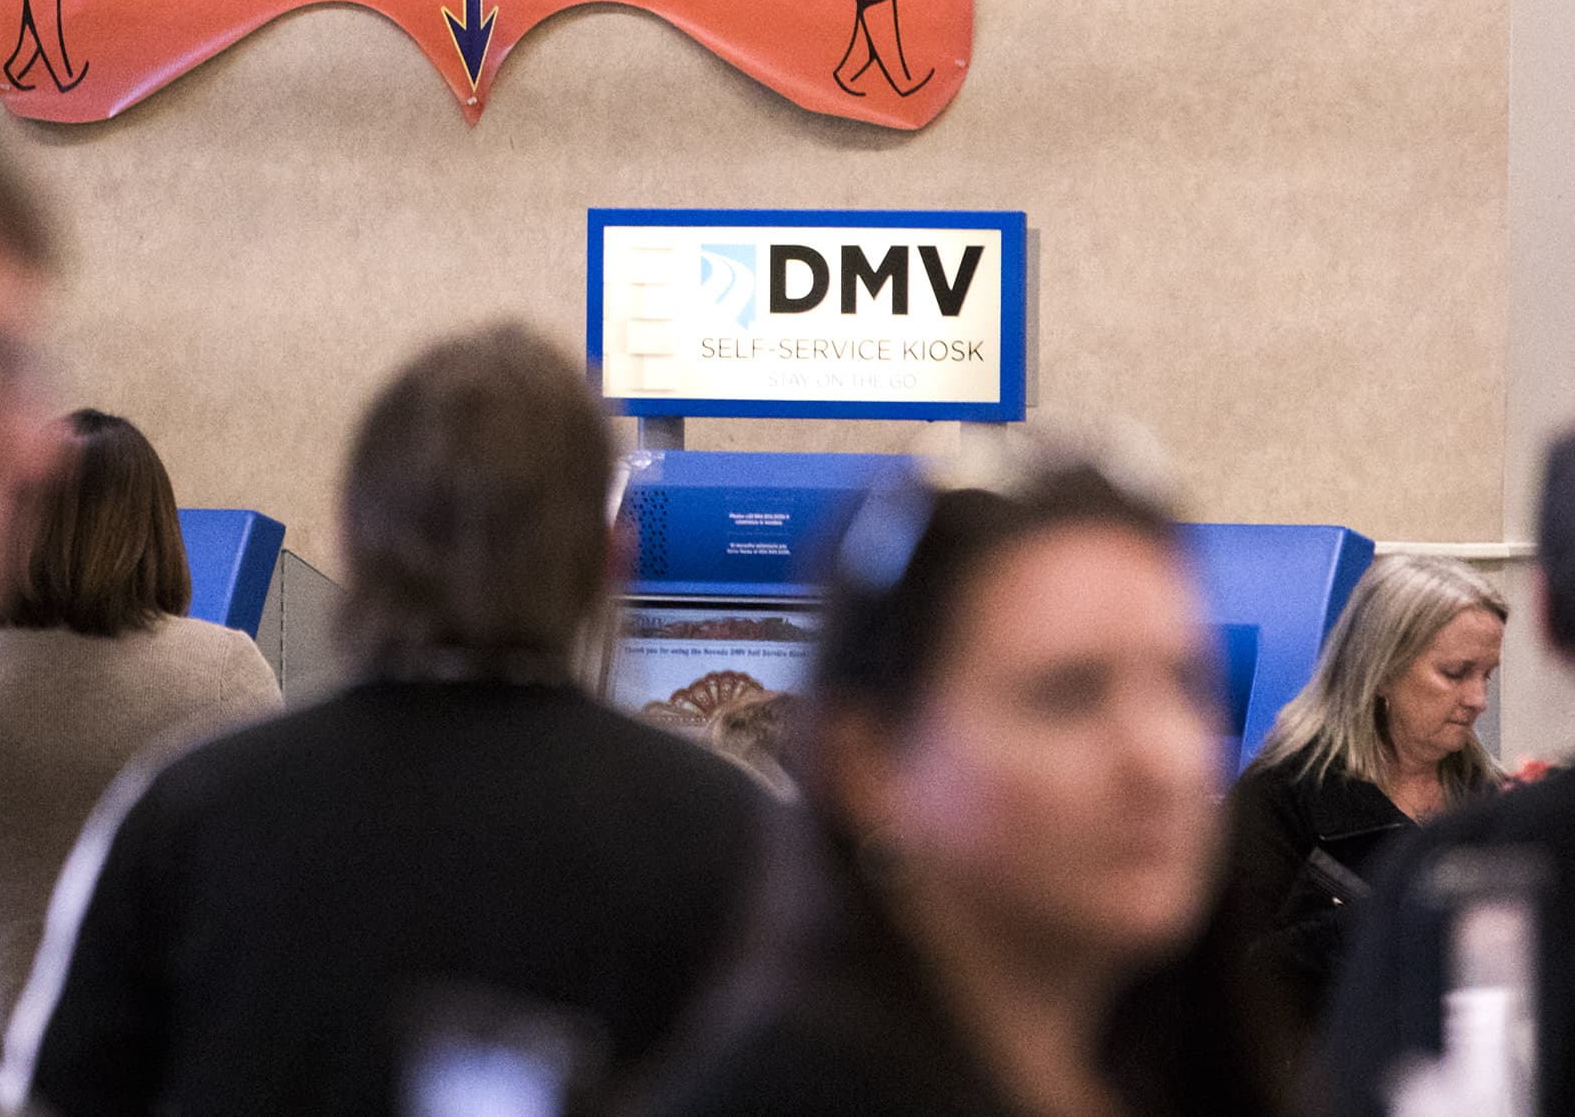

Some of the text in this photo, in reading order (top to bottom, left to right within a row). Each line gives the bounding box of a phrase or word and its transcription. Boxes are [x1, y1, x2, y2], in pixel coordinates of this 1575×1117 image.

[769, 244, 985, 317] DMV
[701, 337, 985, 362] SELF-SERVICE KIOSK
[768, 372, 917, 389] STAY ON THE GO
